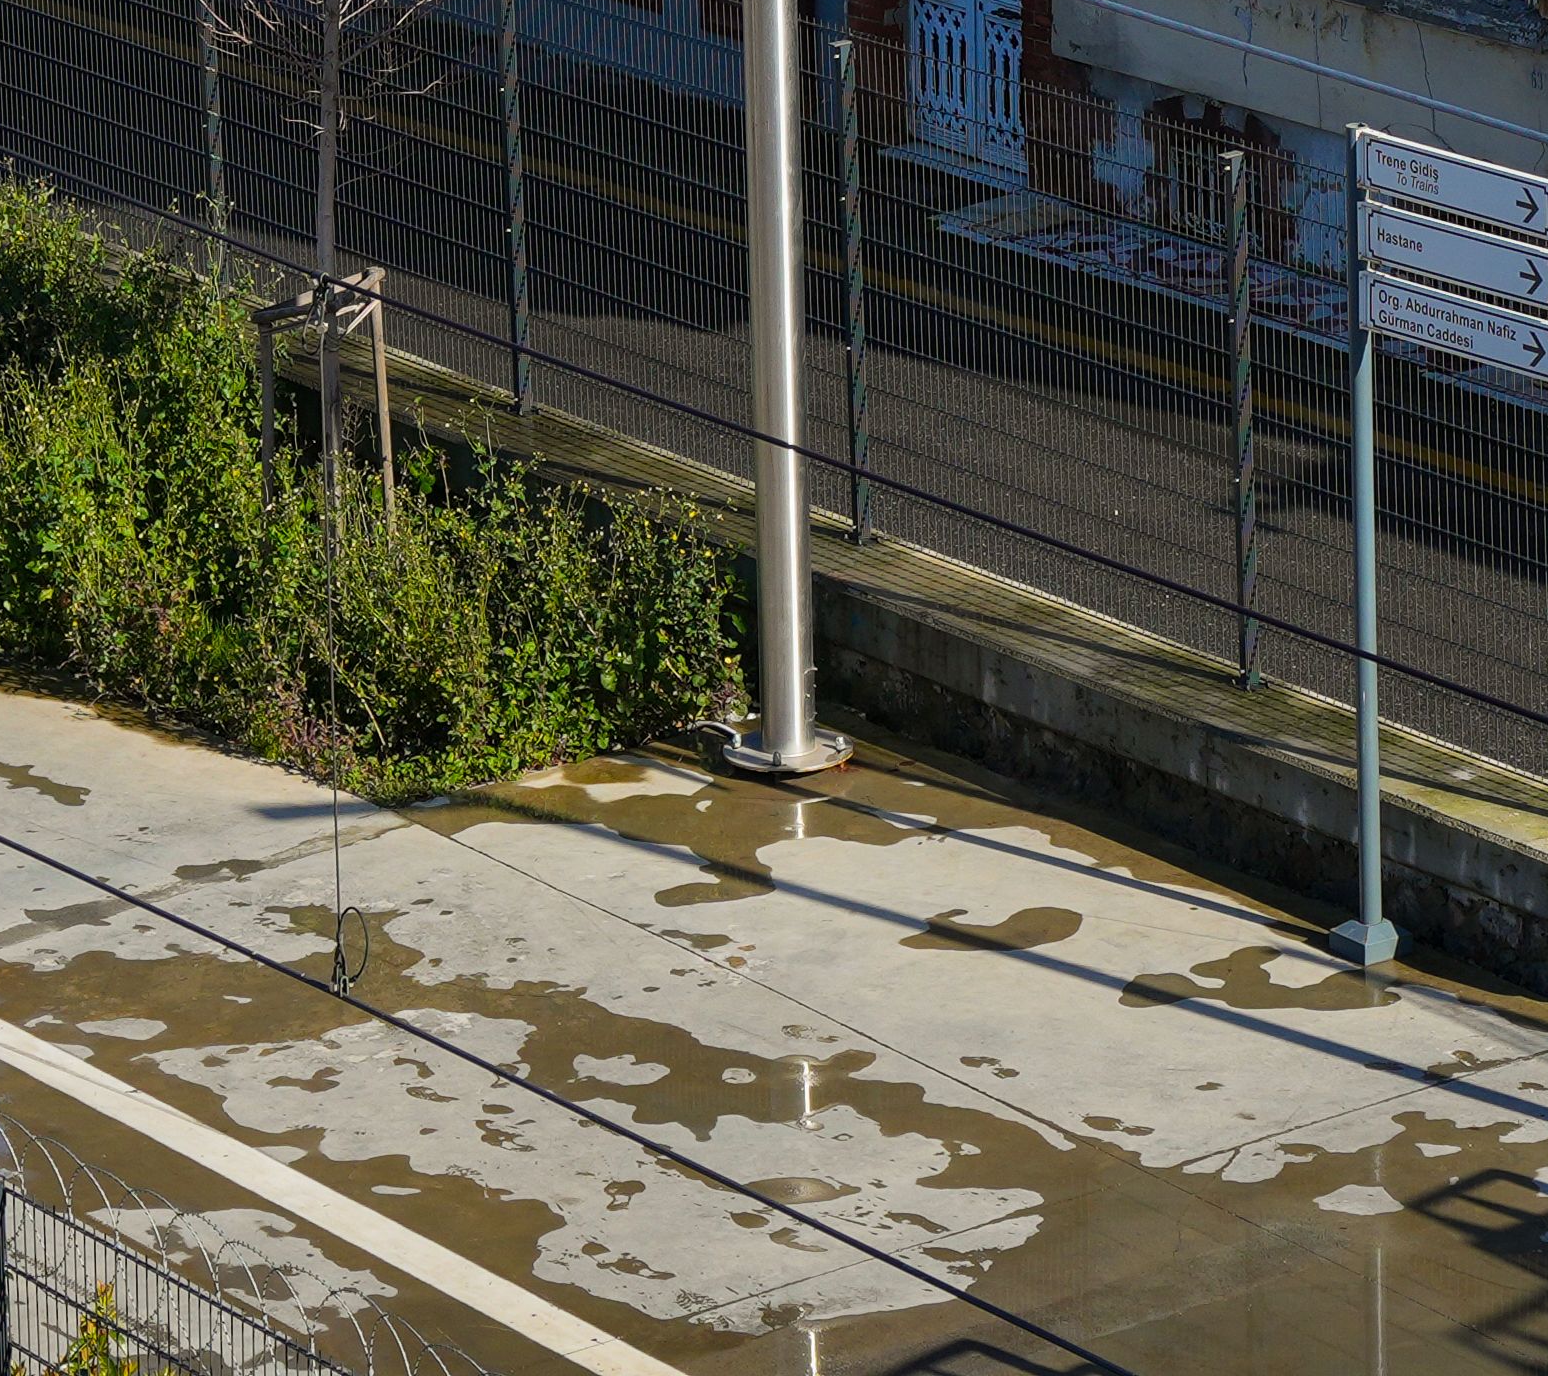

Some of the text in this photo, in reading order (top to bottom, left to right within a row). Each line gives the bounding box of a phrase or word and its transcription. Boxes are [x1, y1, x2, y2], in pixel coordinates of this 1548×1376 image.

[1375, 149, 1440, 183] Trene Gidiş
[1396, 171, 1440, 195] To Trains
[1377, 226, 1423, 253] Hastane
[1378, 289, 1517, 341] Org. Abdurrahman Nafiz
[1378, 309, 1474, 349] Gürman Caddesi
